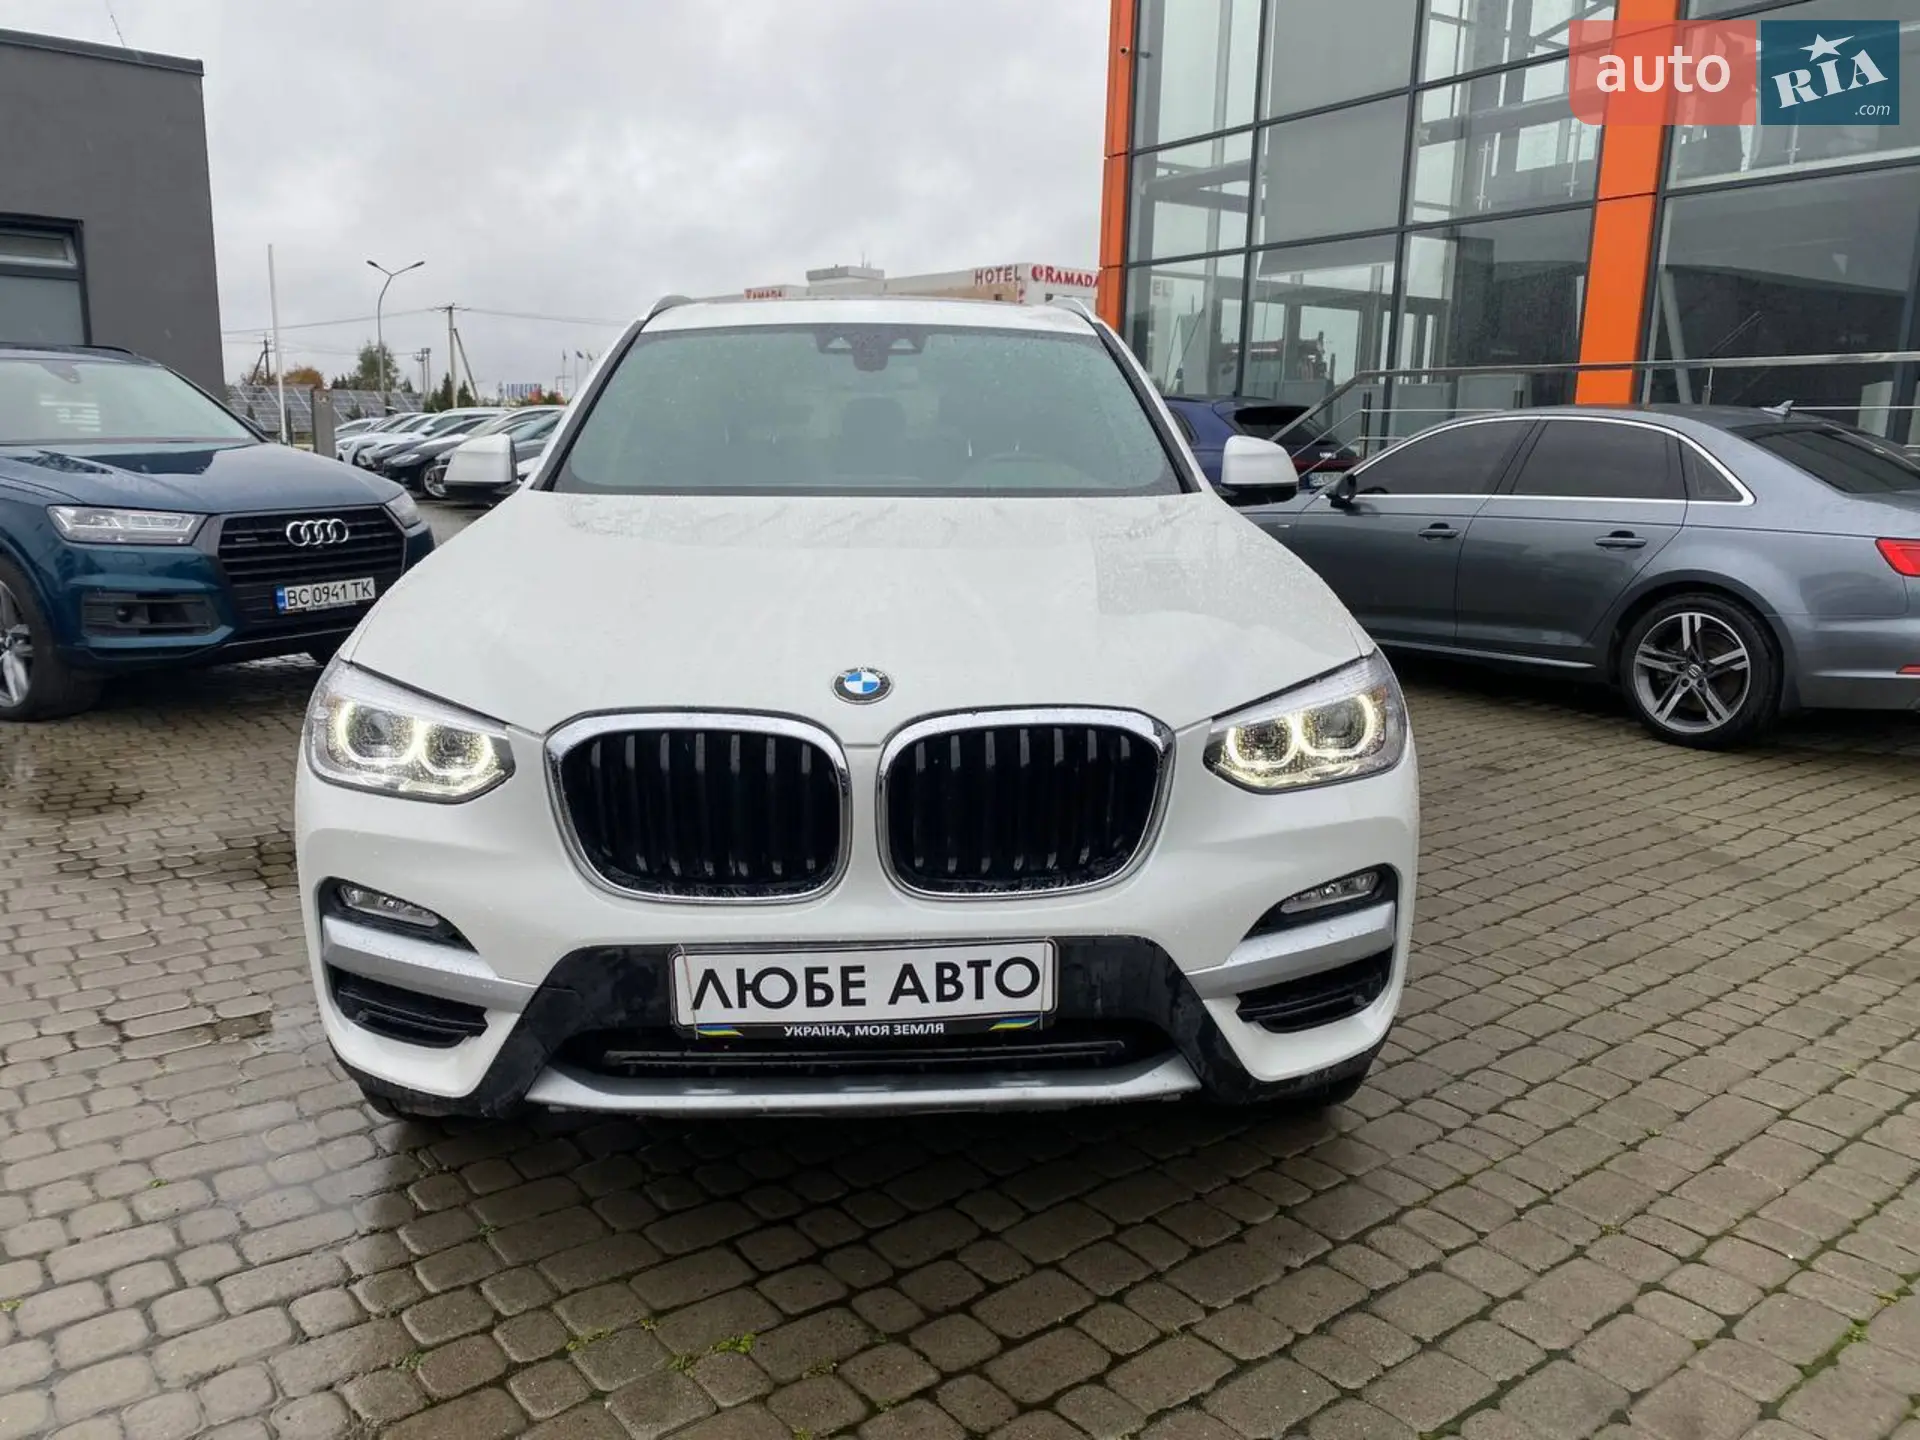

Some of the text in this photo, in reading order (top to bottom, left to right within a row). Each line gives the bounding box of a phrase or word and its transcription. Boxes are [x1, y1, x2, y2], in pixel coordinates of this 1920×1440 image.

[974, 264, 1021, 285] HOTEL
[313, 584, 348, 603] 0941
[691, 956, 1040, 1009] ЛЮБЕ АВТО
[784, 1023, 944, 1038] УКРАЇНА, МОЯ ЗЕМЛЯ
